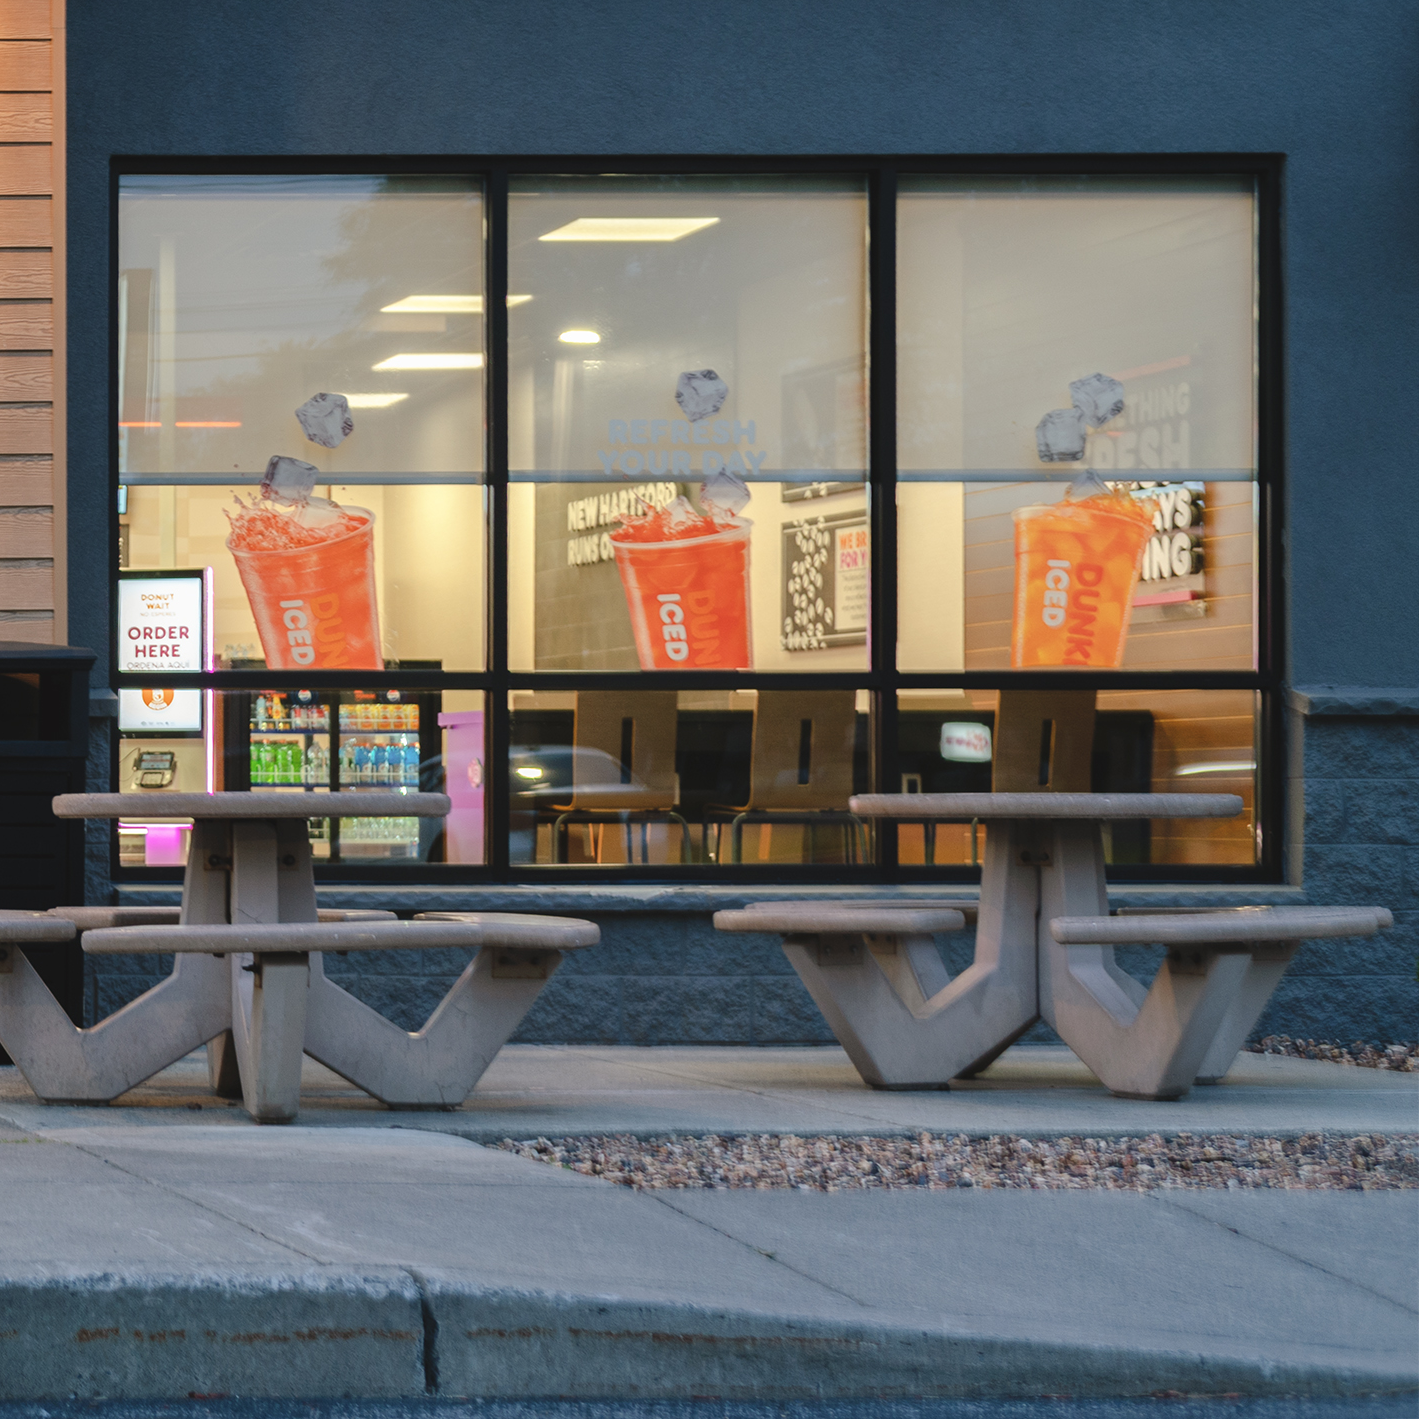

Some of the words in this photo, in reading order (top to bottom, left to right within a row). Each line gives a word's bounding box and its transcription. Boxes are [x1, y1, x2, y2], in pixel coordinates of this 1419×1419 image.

[608, 419, 757, 445] REFRESH
[597, 449, 692, 476] YOUR
[702, 450, 767, 476] DAY
[567, 496, 599, 532] NEW
[567, 533, 600, 567] RUNS
[140, 593, 175, 601] DONUT
[145, 602, 170, 610] WAIT
[1042, 559, 1072, 629] ICED
[127, 625, 190, 641] ORDER
[279, 598, 316, 666] ICED
[656, 592, 690, 662] ICED
[134, 644, 181, 658] HERE
